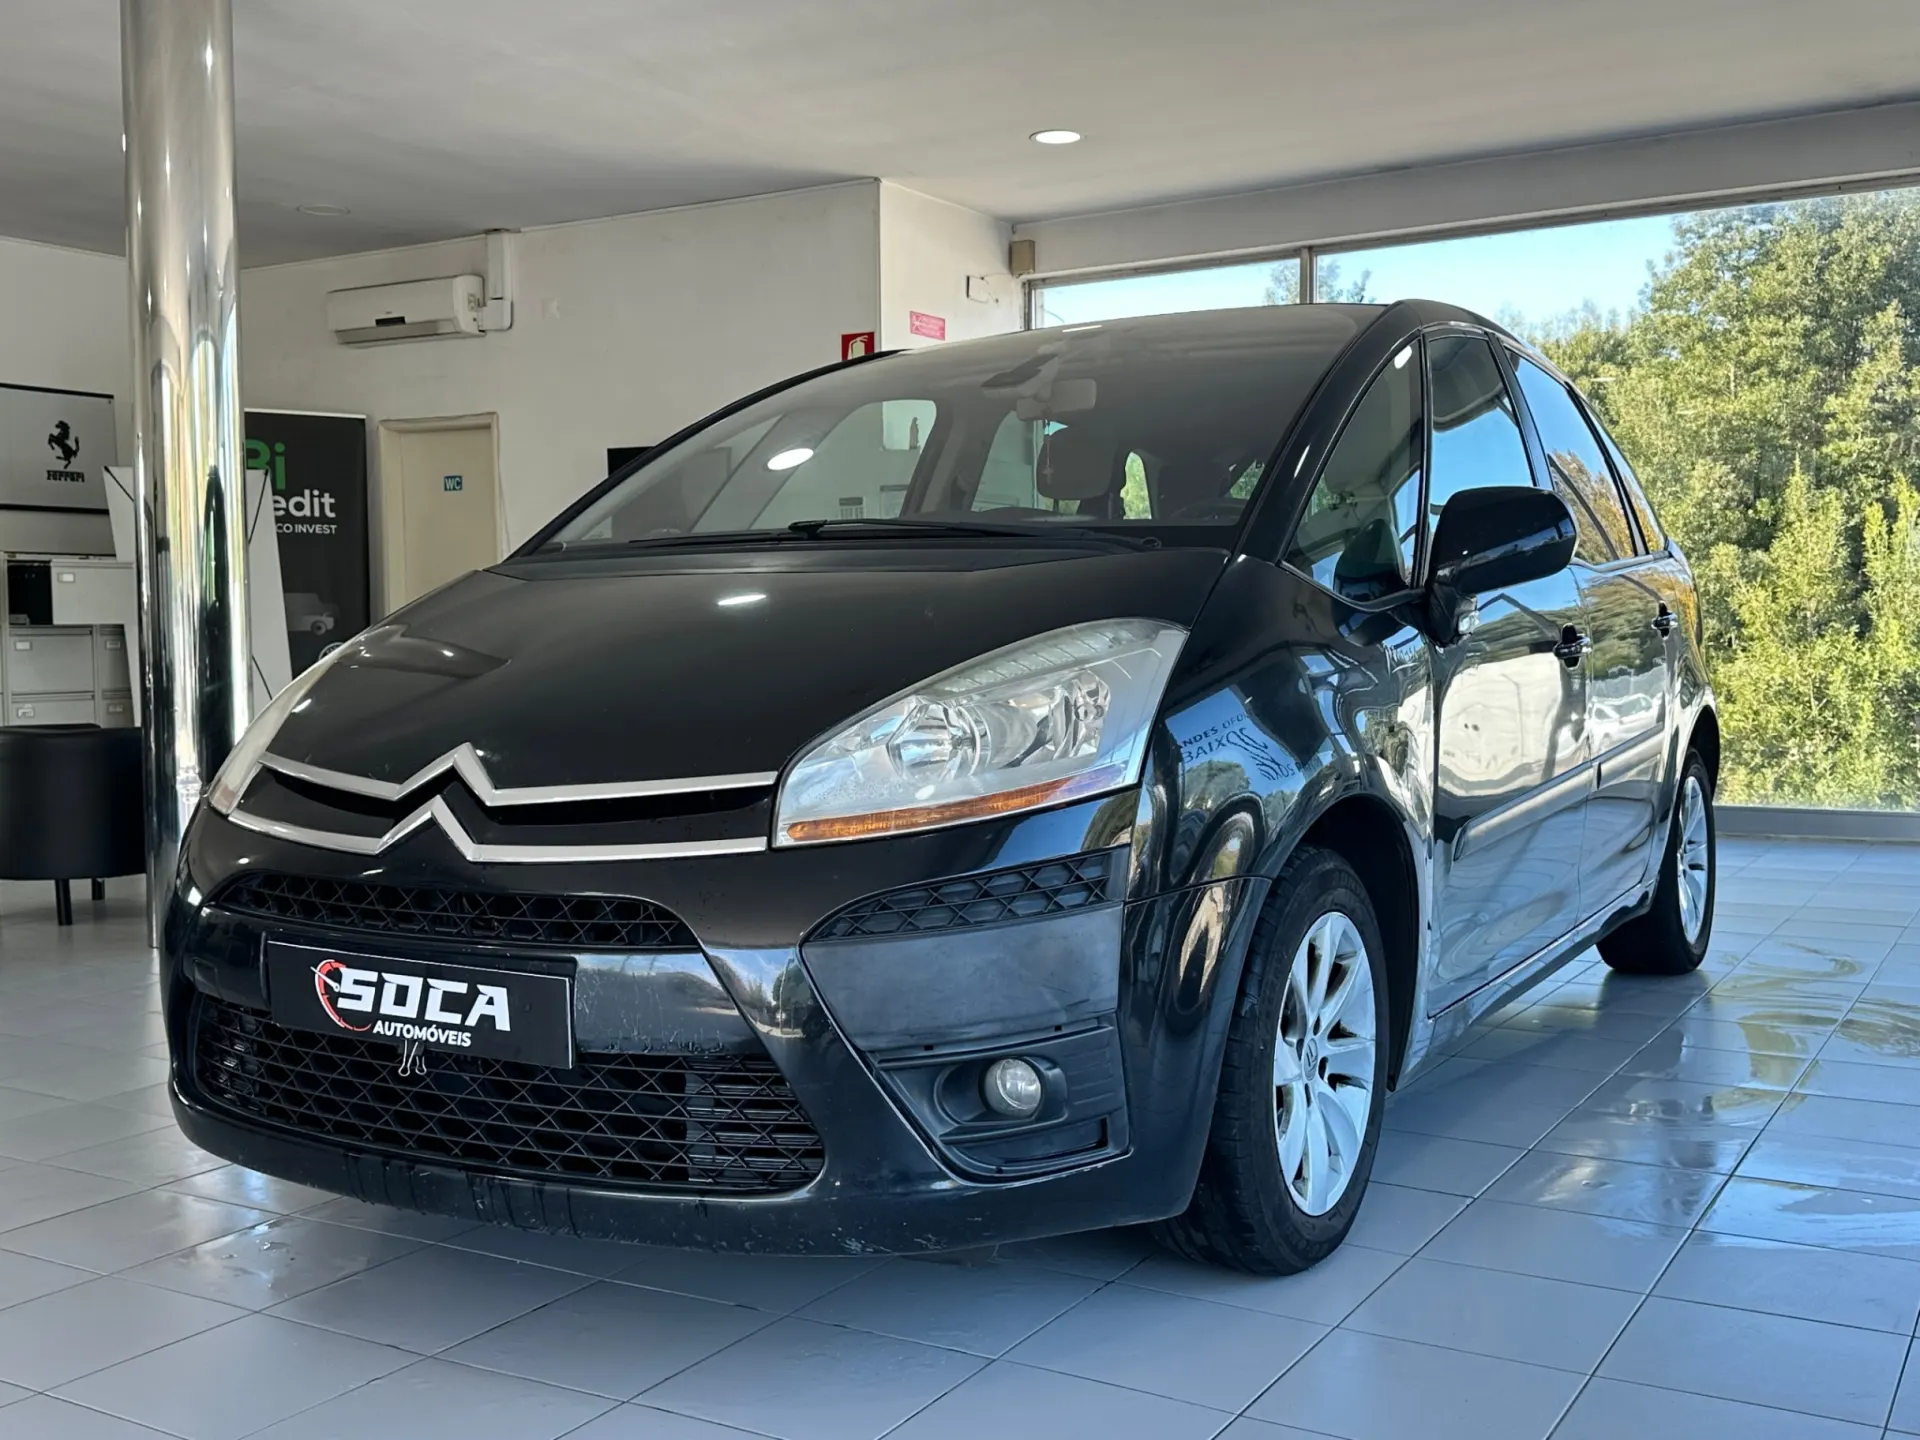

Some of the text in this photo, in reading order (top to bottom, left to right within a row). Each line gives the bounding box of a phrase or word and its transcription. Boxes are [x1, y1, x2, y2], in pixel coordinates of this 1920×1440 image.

[445, 477, 462, 490] WC
[295, 524, 337, 535] INVEST
[1180, 726, 1219, 747] NDES
[336, 967, 511, 1031] SOCA
[373, 1019, 472, 1047] AUTOMÓVEIS
